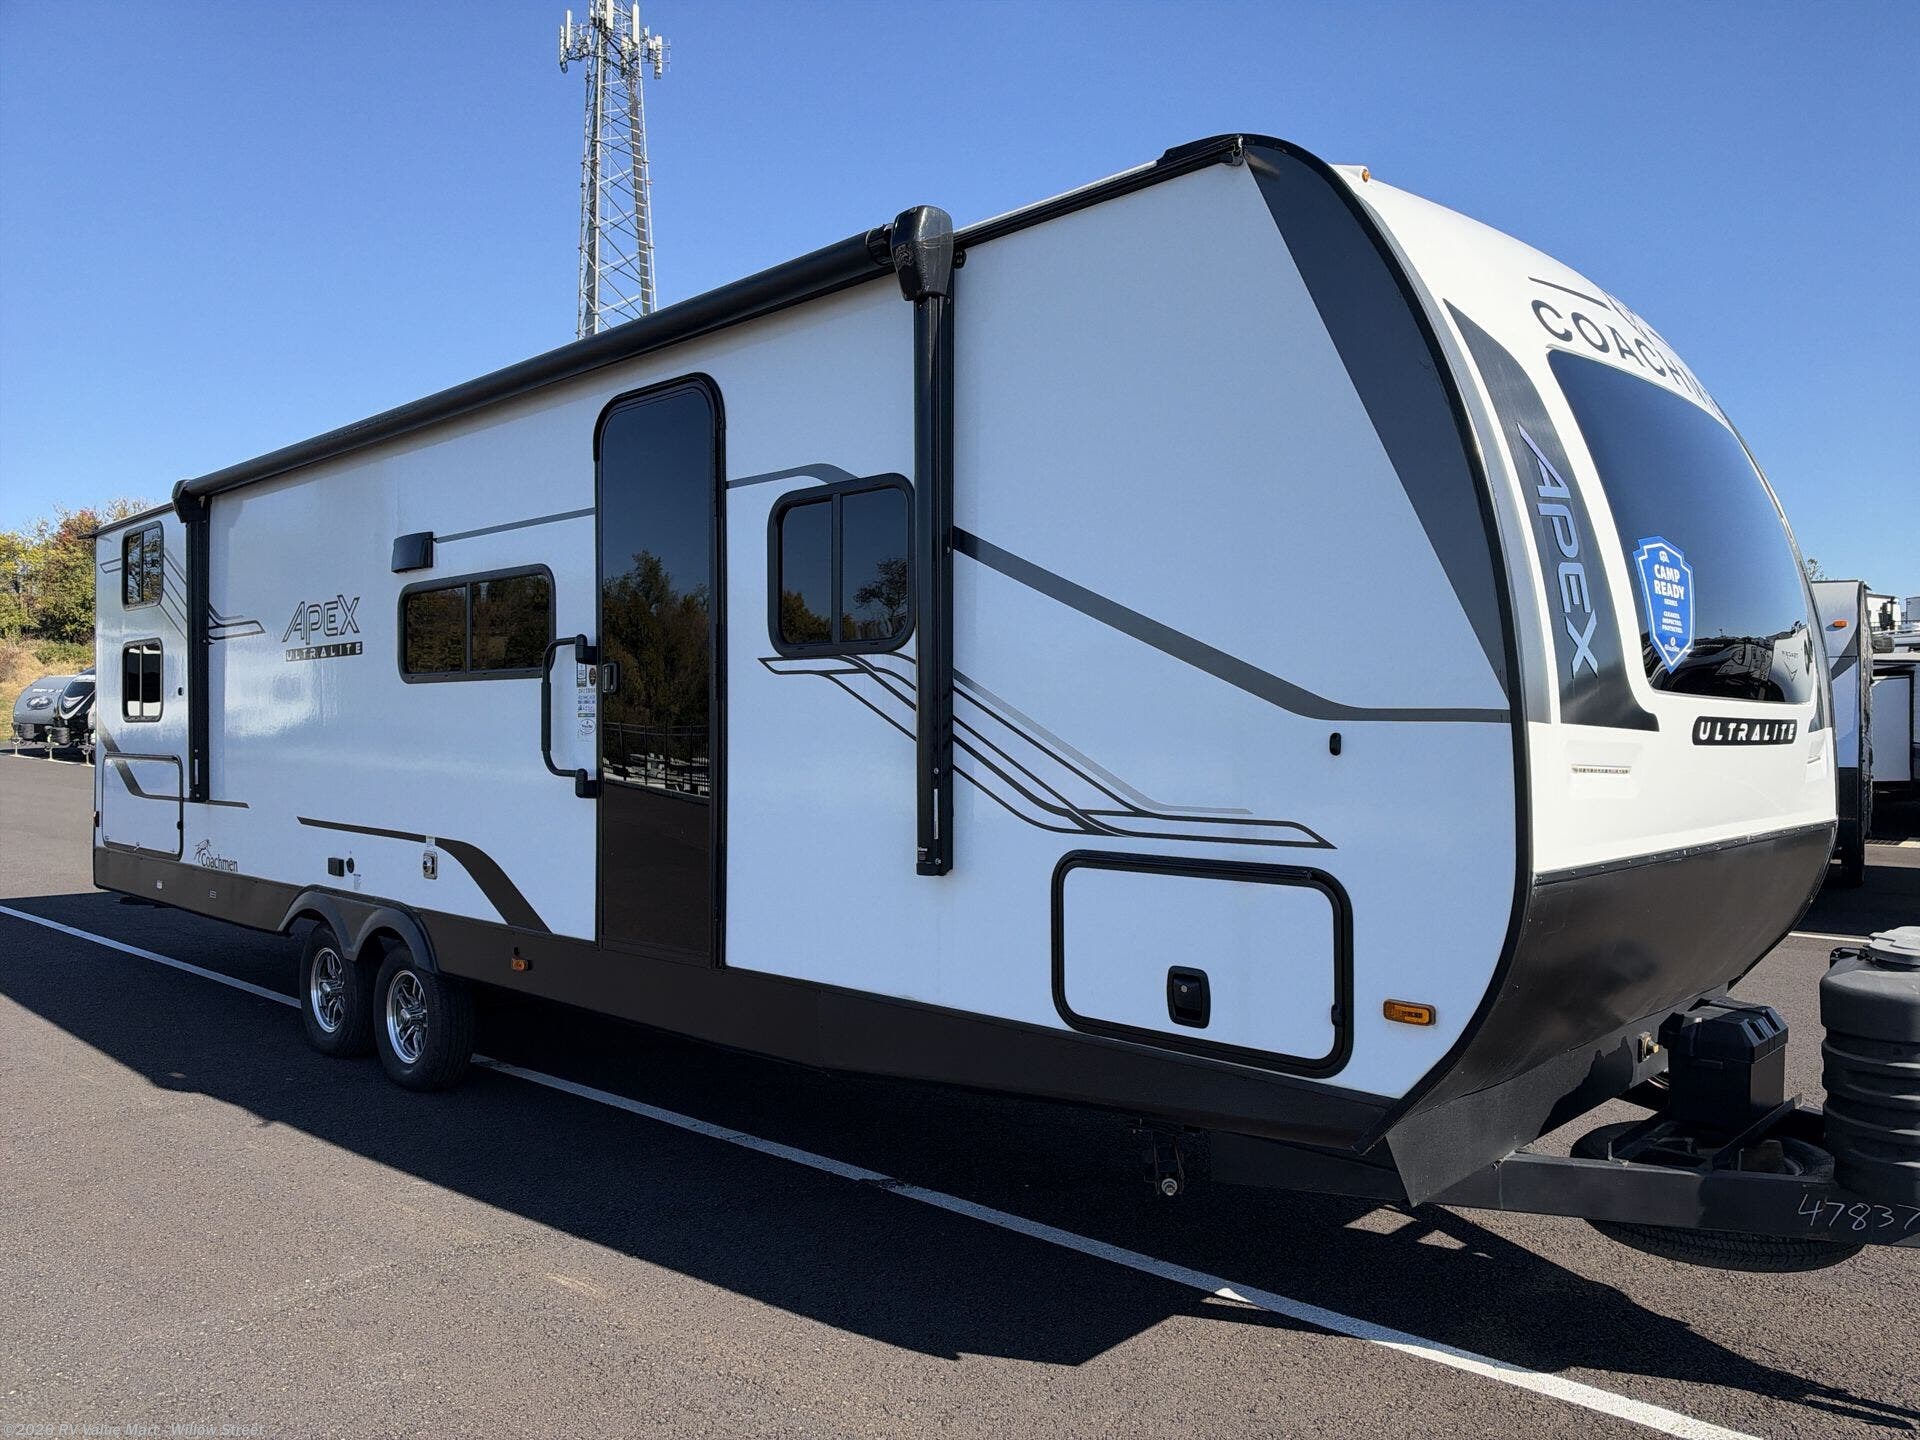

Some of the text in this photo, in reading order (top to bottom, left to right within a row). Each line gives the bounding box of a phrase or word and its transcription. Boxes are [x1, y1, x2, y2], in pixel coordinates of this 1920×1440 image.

[1517, 423, 1598, 679] APEX
[1654, 564, 1680, 582] CAMP
[1654, 580, 1685, 600] READY
[282, 594, 360, 645] APEX
[286, 644, 361, 660] ULTRALITE
[1700, 721, 1795, 741] ULTRALITE
[201, 852, 238, 873] Coachmen
[1798, 1193, 1920, 1231] 47837
